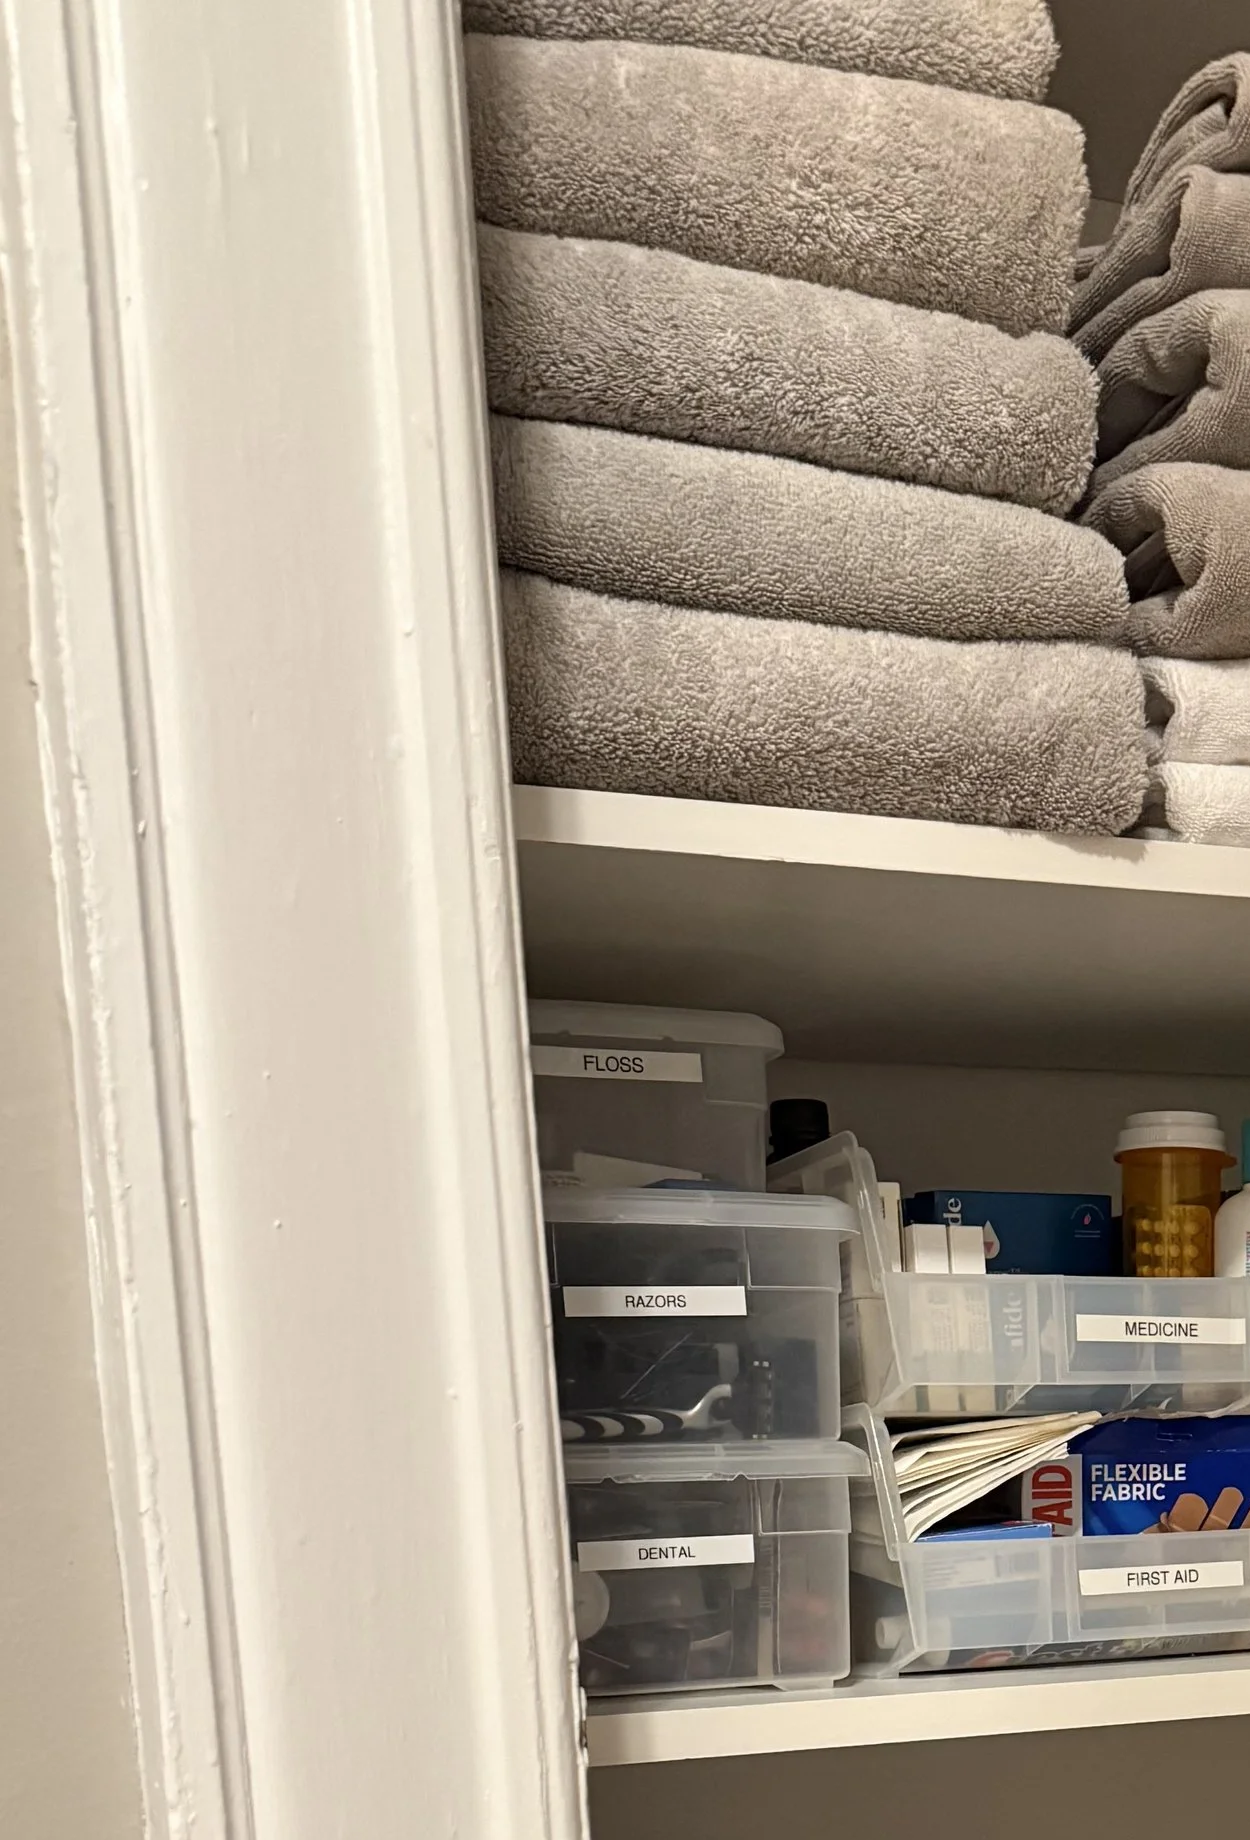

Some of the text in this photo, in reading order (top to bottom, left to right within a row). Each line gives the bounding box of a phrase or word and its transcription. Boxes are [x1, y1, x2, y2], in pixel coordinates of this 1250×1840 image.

[583, 1055, 644, 1073] FLOSS
[625, 1295, 686, 1308] RAZORS
[1125, 1321, 1198, 1337] MEDICINE
[1091, 1463, 1187, 1482] FLEXIBLE
[1091, 1483, 1166, 1502] FABRIC
[638, 1546, 696, 1560] DENTAL
[1127, 1569, 1199, 1587] FIRST AID
